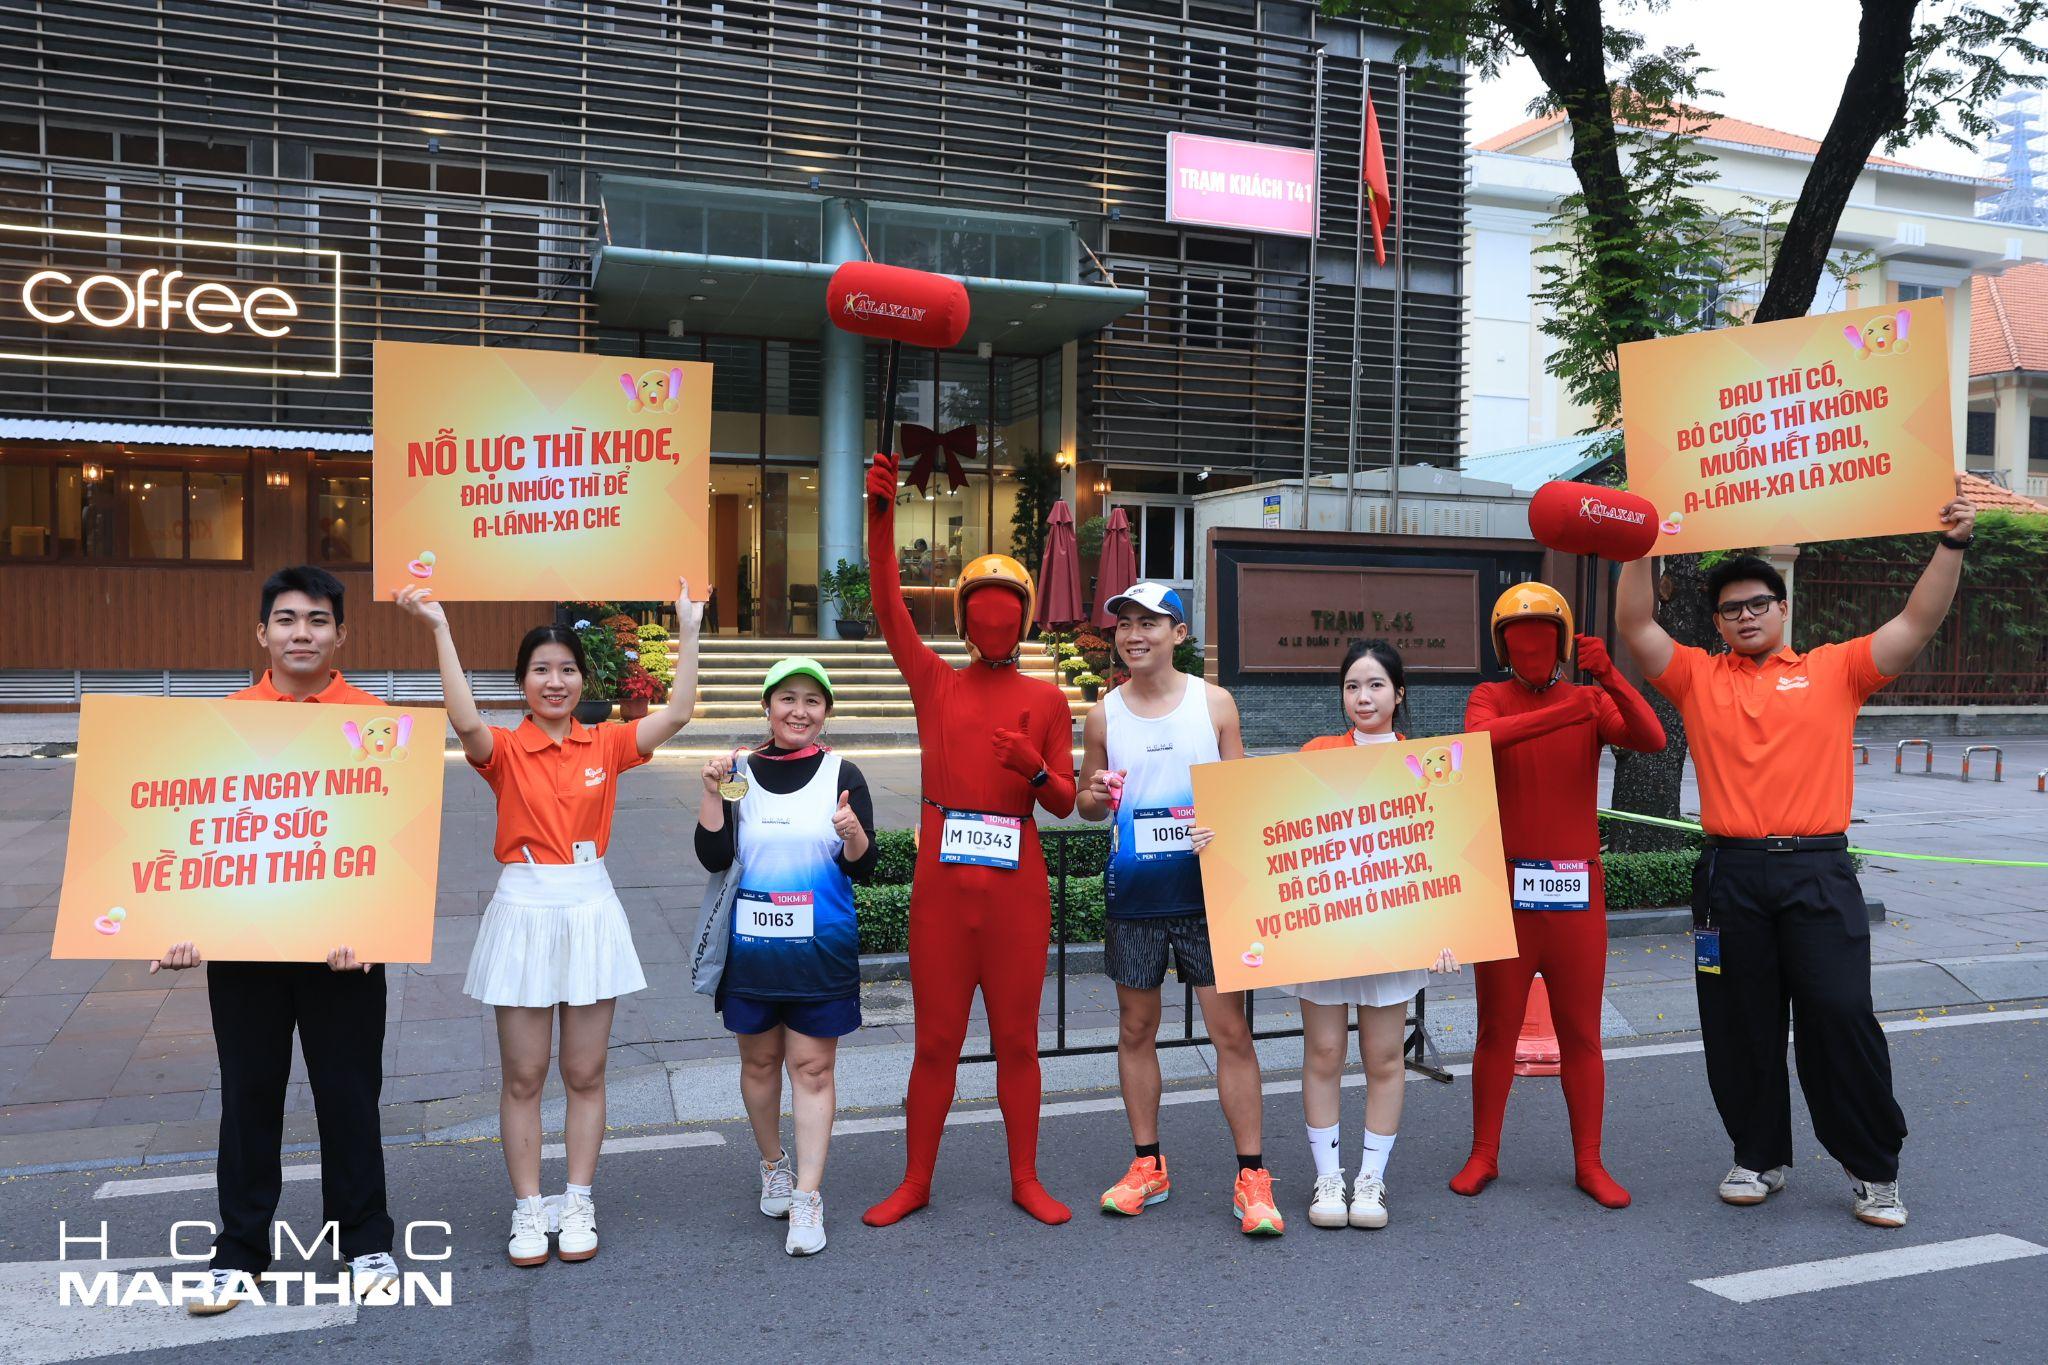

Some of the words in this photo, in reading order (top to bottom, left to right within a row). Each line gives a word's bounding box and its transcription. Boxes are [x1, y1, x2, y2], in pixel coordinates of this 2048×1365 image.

[1179, 168, 1225, 196] TRẠM
[1230, 173, 1283, 200] KHÁCH
[1286, 181, 1312, 203] T41
[22, 268, 298, 338] coffee
[1719, 381, 1762, 409] ĐAU
[1767, 368, 1801, 396] THÌ
[1806, 360, 1842, 389] CÓ,
[1677, 421, 1705, 451] BỎ
[1709, 412, 1766, 443] CUỘC
[1771, 401, 1805, 430] THÌ
[1810, 386, 1889, 421] KHÔNG
[407, 428, 457, 477] NỖ
[466, 435, 525, 479] LỰC
[534, 426, 586, 468] THÌ
[591, 428, 680, 465] KHOE,
[1700, 442, 1767, 478] MUỐN
[1772, 431, 1810, 464] HẾT
[1816, 425, 1868, 454] ĐAU,
[461, 483, 503, 506] ĐAU
[508, 476, 564, 502] NHỨC
[569, 473, 600, 498] THÌ
[604, 466, 630, 495] ĐỂ
[1684, 472, 1795, 514] A-LÁNH-XA
[1800, 463, 1825, 490] LÀ
[1829, 453, 1891, 484] XONG
[473, 509, 578, 538] A-LÁNH-XA
[584, 506, 621, 528] CHE
[1310, 609, 1364, 634] TRẠM
[130, 776, 216, 812] CHẠM
[222, 775, 238, 802] E
[242, 771, 321, 800] NGAY
[324, 766, 388, 797] NHA,
[189, 819, 204, 845] E
[212, 807, 267, 844] TIẾP
[273, 807, 328, 839] SỨC
[950, 830, 962, 843] M
[967, 831, 1012, 849] 10343
[989, 815, 1009, 825] 10KM
[1263, 818, 1313, 846] SÁNG
[1317, 809, 1354, 834] NAY
[1359, 804, 1376, 824] ĐI
[1381, 792, 1433, 819] CHẠY,
[132, 849, 176, 894] VỀ
[179, 850, 256, 890] ĐÍCH
[266, 842, 326, 883] THẢ
[332, 845, 376, 878] GA
[1266, 851, 1298, 875] XIN
[1301, 838, 1346, 870] PHÉP
[1350, 833, 1375, 856] VỢ
[1378, 821, 1435, 851] CHƯA?
[777, 895, 800, 903] 10KM
[1278, 877, 1303, 902] ĐÃ
[1307, 870, 1331, 896] CÓ
[1335, 853, 1432, 889] A-LÁNH-XA,
[1523, 878, 1534, 891] M
[1539, 879, 1581, 892] 10859
[752, 912, 794, 927] 10163
[1256, 914, 1281, 938] VỢ
[1285, 902, 1320, 931] CHỜ
[1325, 896, 1362, 922] ANH
[1366, 889, 1378, 913] Ở
[1382, 880, 1420, 908] NHÀ
[1423, 874, 1461, 898] NHA
